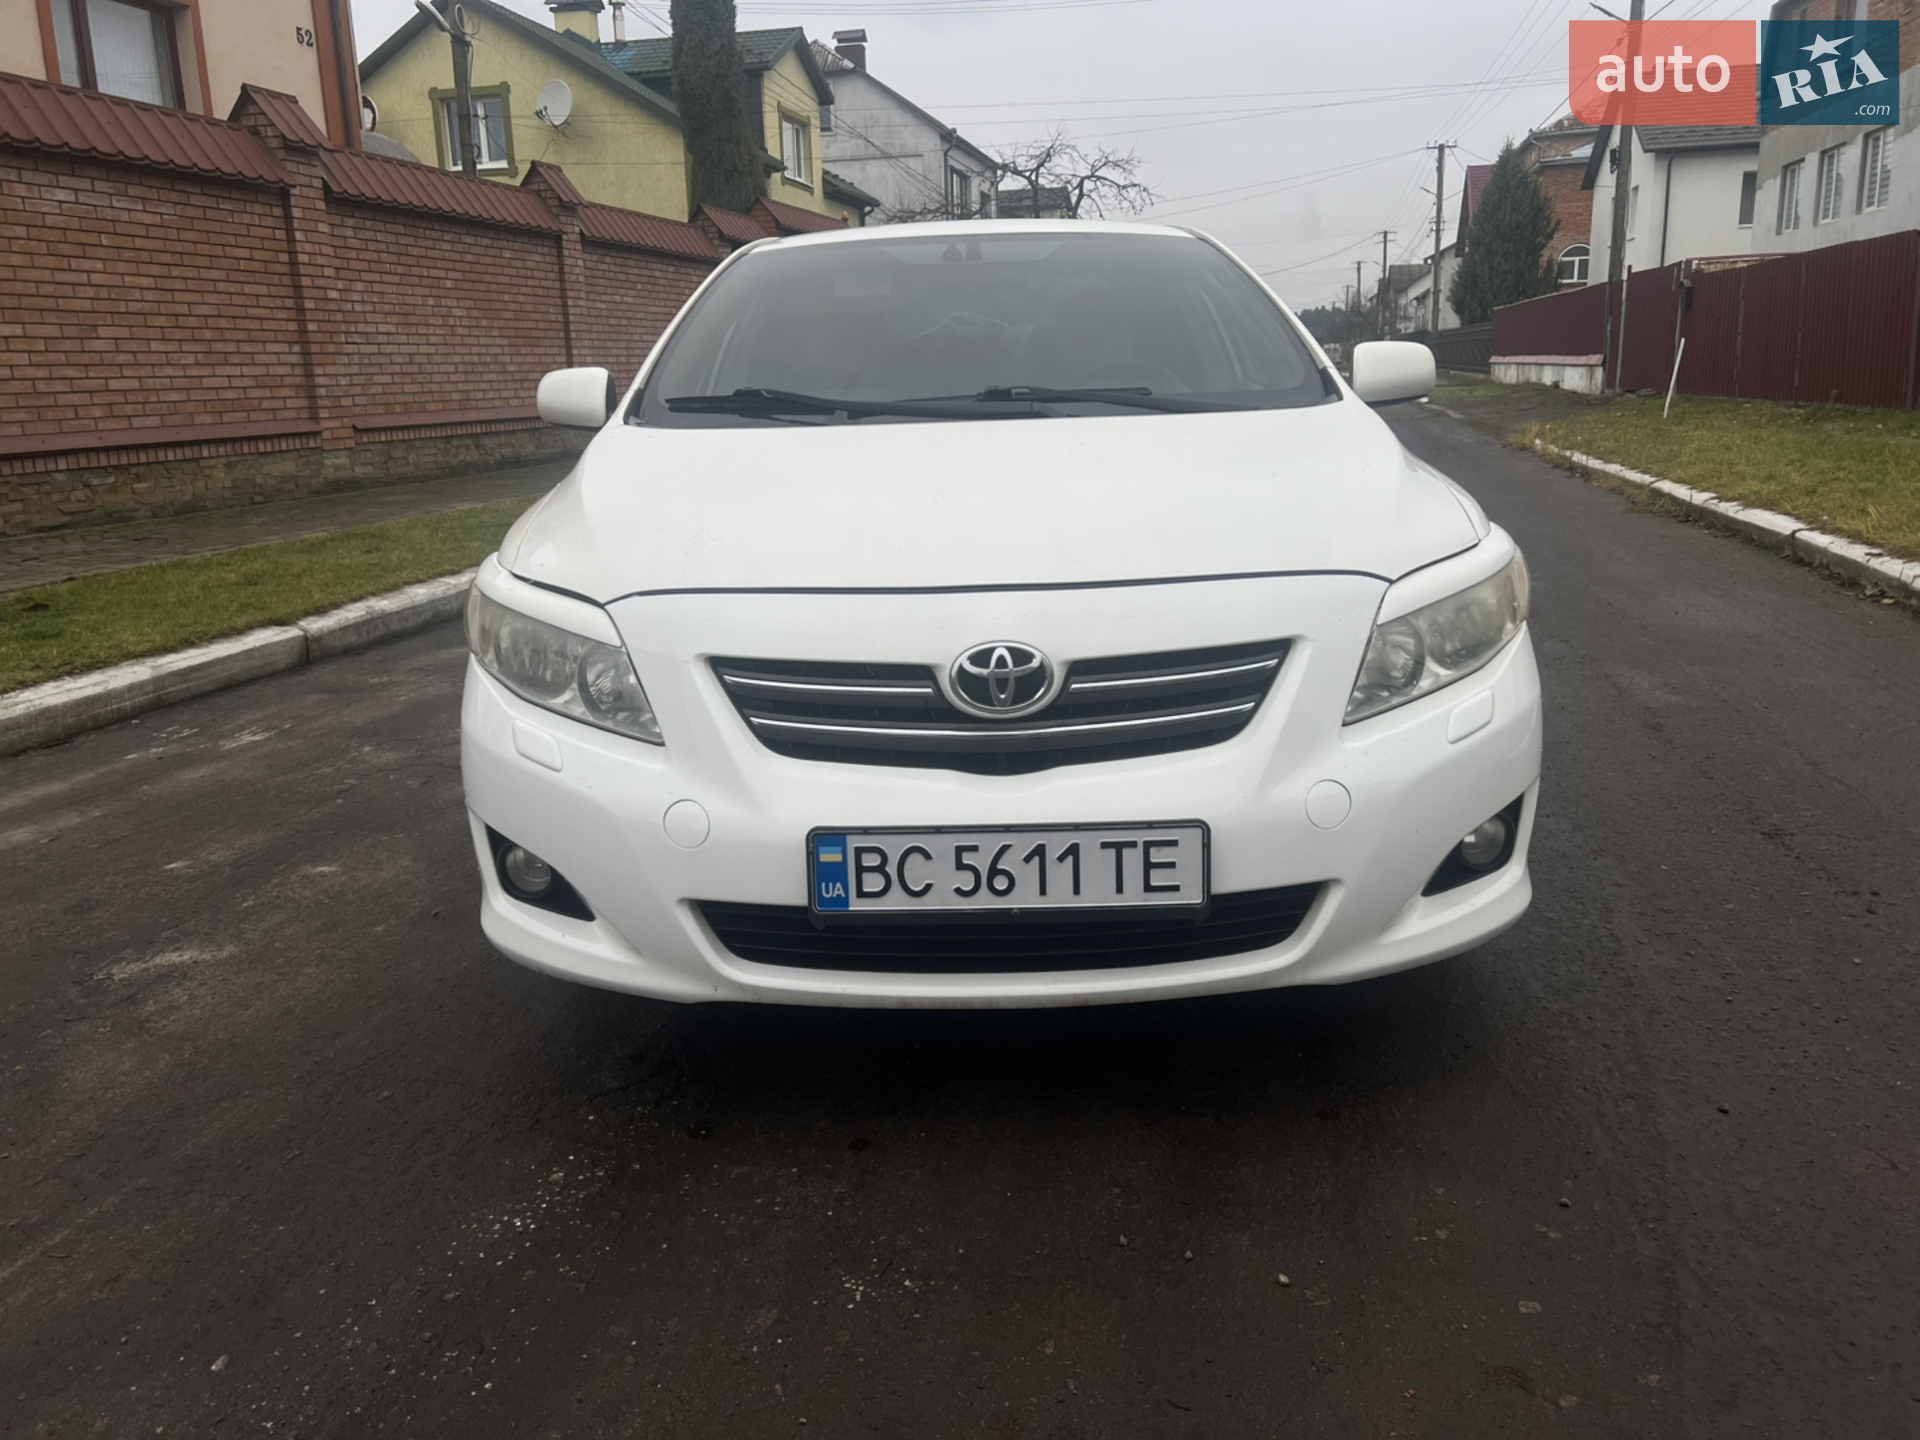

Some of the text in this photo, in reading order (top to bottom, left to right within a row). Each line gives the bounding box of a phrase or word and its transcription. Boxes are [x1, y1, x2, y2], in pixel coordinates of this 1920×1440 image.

[296, 26, 314, 47] 52
[853, 838, 1181, 898] BC 5611 TE
[821, 881, 846, 898] UA
